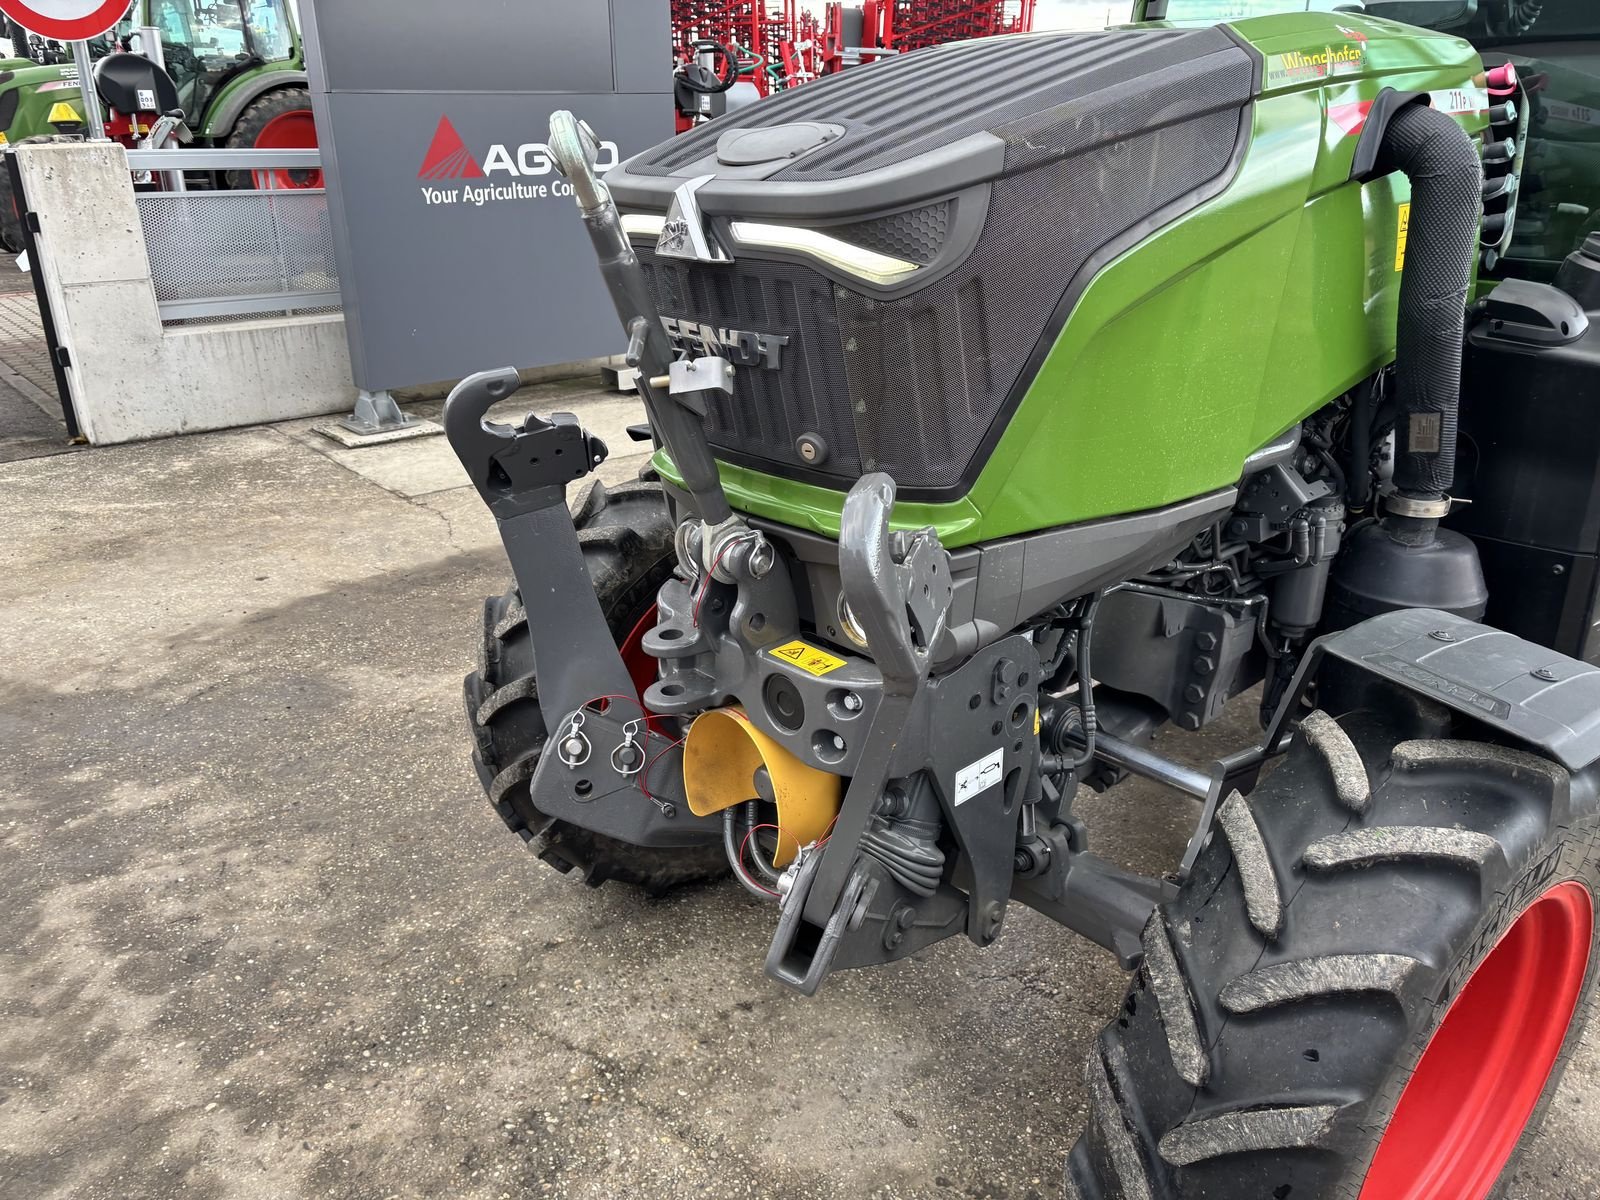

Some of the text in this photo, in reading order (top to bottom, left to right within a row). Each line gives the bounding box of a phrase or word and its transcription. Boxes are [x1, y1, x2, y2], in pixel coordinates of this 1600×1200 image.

[482, 141, 619, 177] AGO
[422, 186, 458, 205] Your
[462, 181, 547, 206] Agriculture
